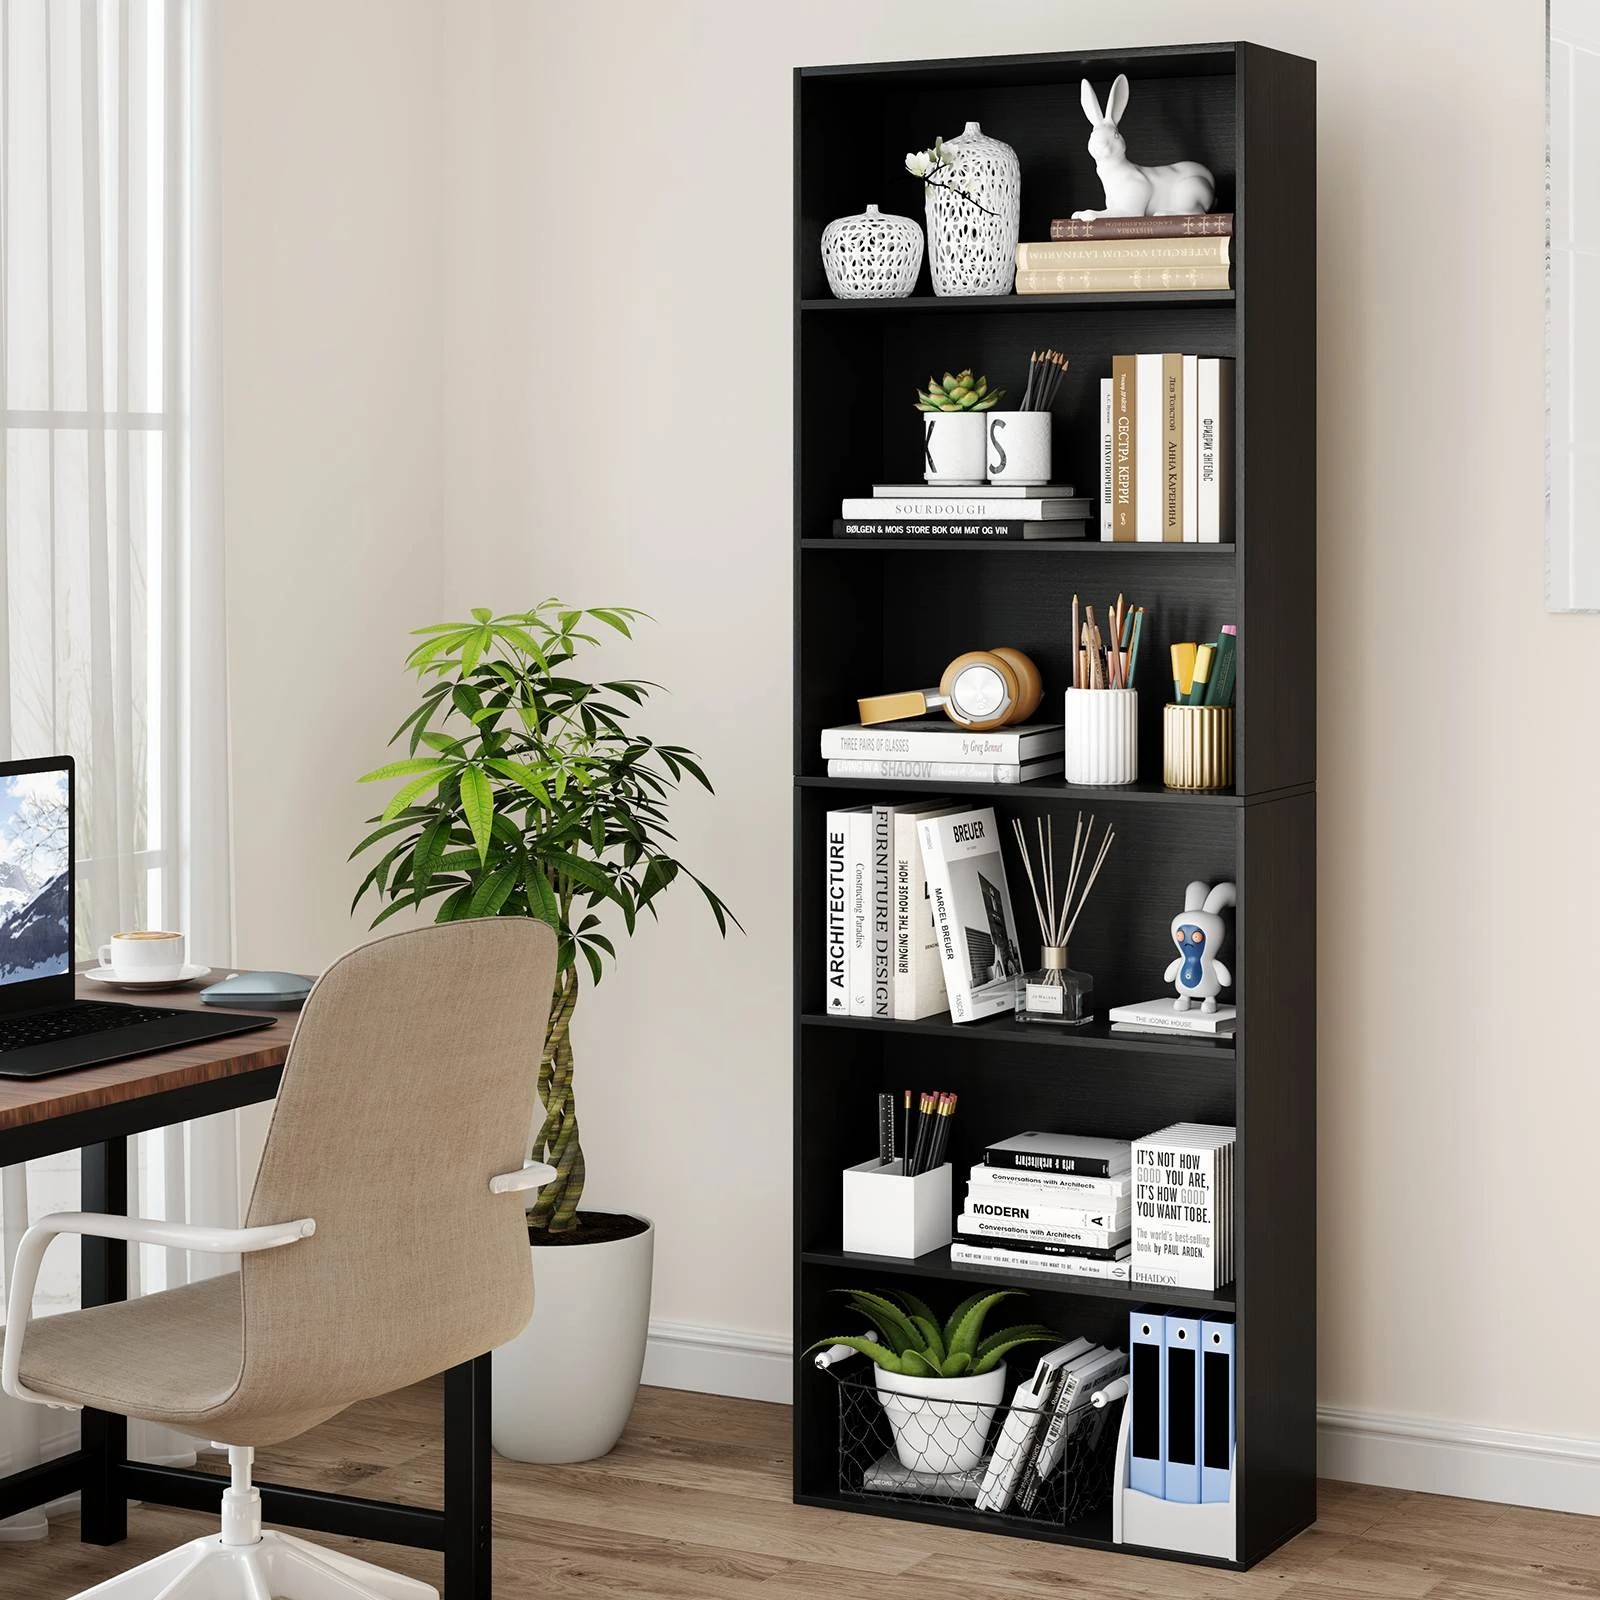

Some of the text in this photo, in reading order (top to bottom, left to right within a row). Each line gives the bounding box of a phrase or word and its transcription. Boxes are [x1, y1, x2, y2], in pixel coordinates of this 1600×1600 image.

[923, 420, 938, 474] K
[989, 418, 1007, 474] S
[1118, 416, 1130, 504] СЕСТРА КЕРРИ
[1168, 441, 1178, 527] АННА КАРЕНИНА
[895, 504, 986, 515] SOURDOUGH
[846, 526, 1008, 535] BØLGEN & MOIS STORE BOK OM MAT OG VIN
[840, 737, 910, 752] THREE PAIRS OF GLASSES
[962, 742, 970, 754] by
[880, 762, 933, 778] SHADOW
[953, 820, 986, 843] BREUER
[854, 862, 864, 914] Constructing
[830, 832, 844, 988] ARCHITECTURE
[876, 811, 888, 1016] FURNITURE DESIGN
[898, 860, 908, 974] BRINGING THE HOUSE HOME
[935, 888, 954, 960] MARCEL BREUER
[1136, 1016, 1146, 1024] THE
[1170, 1020, 1192, 1028] HOUSE
[1137, 1150, 1200, 1170] IT'S NOT HOW
[992, 1174, 1041, 1184] Conversations
[1060, 1180, 1096, 1190] Architects
[1137, 1167, 1210, 1190] GOOD YOU ARE,
[1137, 1184, 1206, 1206] IT'S HOW GOOD
[973, 1204, 1030, 1219] MODERN
[1137, 1201, 1154, 1218] YOU
[1156, 1202, 1182, 1220] WANT
[1092, 1216, 1104, 1226] A
[978, 1223, 1028, 1234] Conversations
[1046, 1230, 1082, 1240] Architects
[1137, 1228, 1210, 1248] The world's best-selling
[1136, 1241, 1204, 1258] book by PAUL ARDEN.
[1135, 1272, 1176, 1284] PHAIDON
